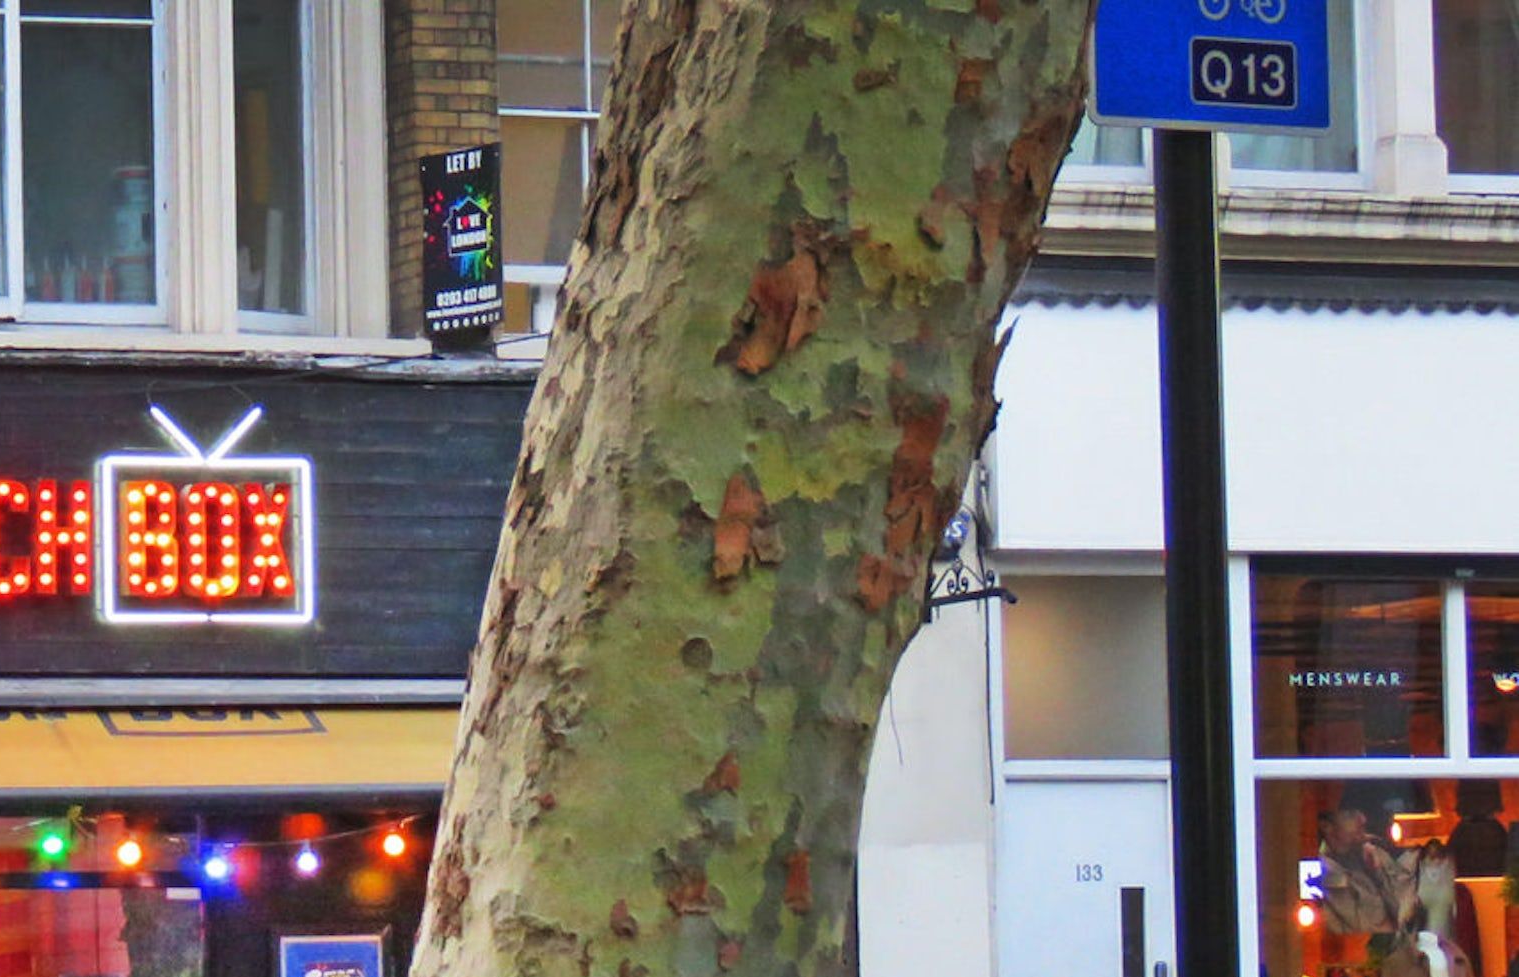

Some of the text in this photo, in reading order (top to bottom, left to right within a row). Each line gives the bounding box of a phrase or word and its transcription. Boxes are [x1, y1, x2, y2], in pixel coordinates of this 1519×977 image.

[1200, 50, 1286, 98] Q13
[446, 150, 482, 173] LET BY
[120, 480, 295, 597] BOX
[1288, 672, 1402, 687] MENSWEAR
[1076, 864, 1103, 882] 133
